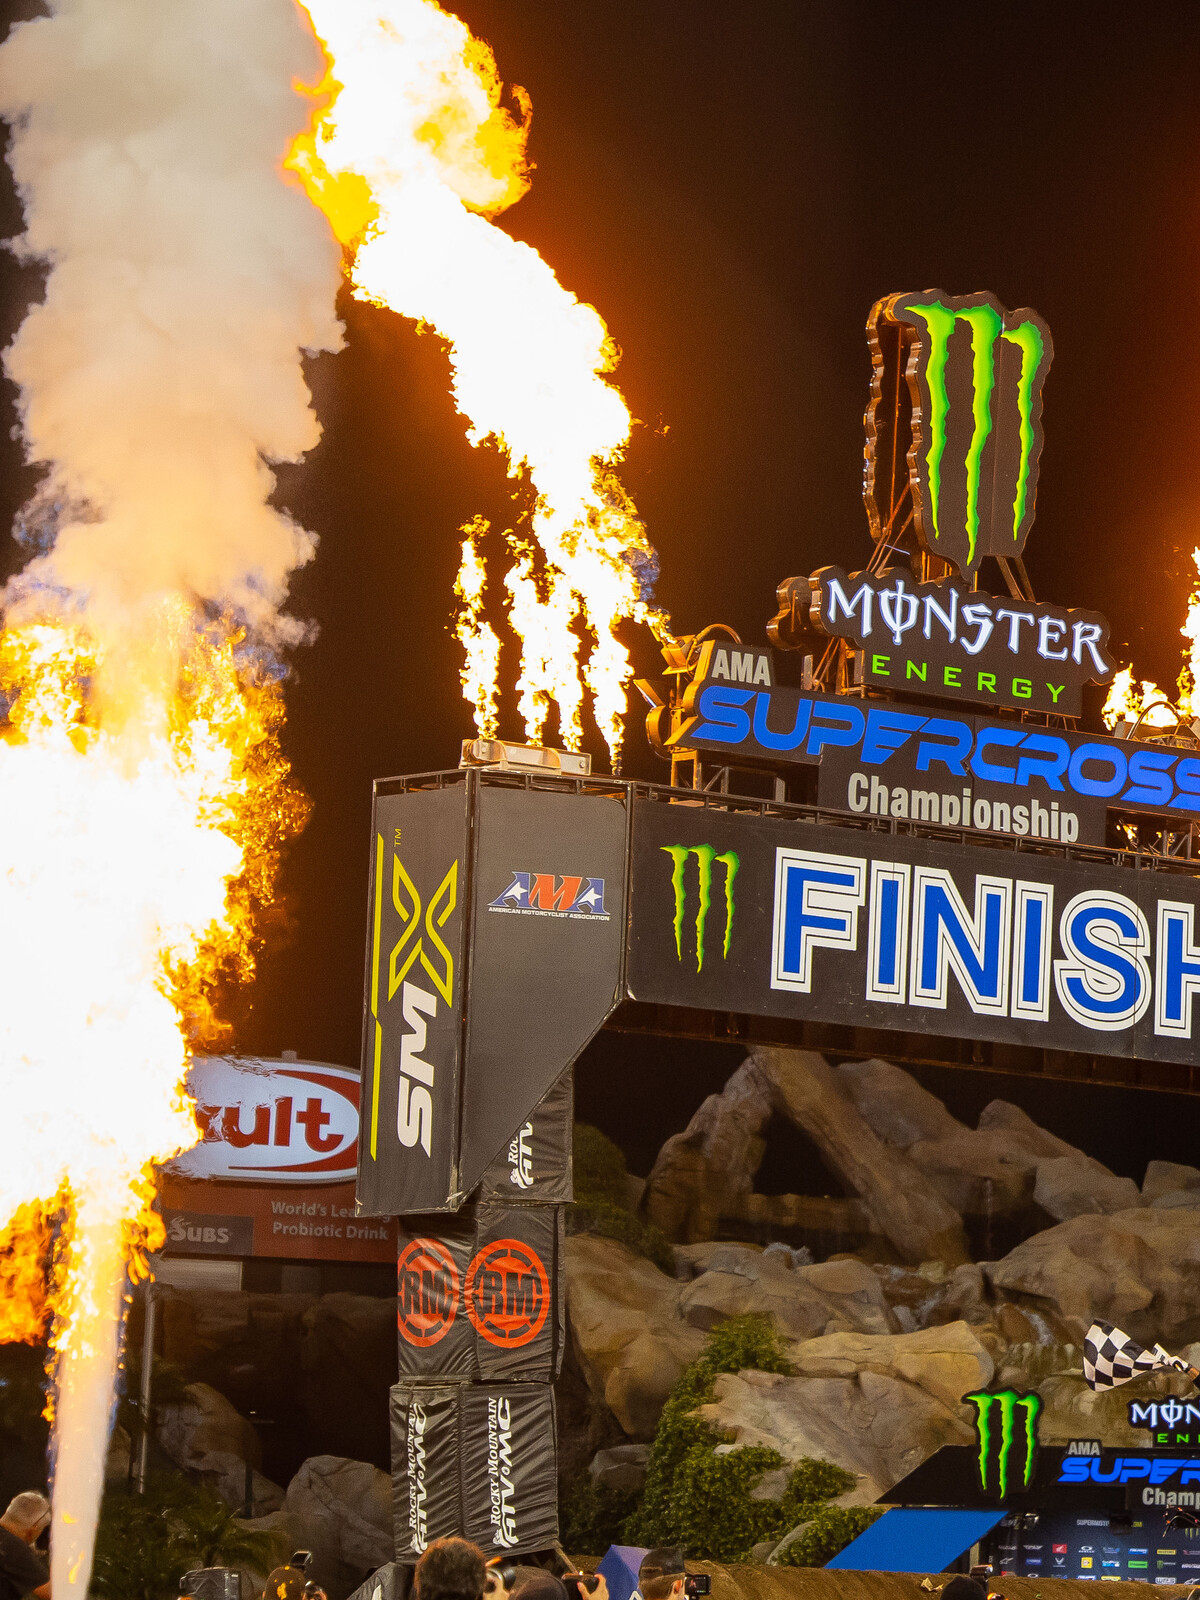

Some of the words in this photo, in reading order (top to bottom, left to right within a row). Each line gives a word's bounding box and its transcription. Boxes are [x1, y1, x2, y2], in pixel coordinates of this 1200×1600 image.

[711, 649, 772, 686] AMA
[872, 655, 1066, 702] ENERGY
[847, 773, 1080, 843] Championship
[487, 871, 611, 915] AMA
[488, 906, 521, 915] AMERICAN
[521, 909, 569, 918] MOTORCYCLIST
[569, 913, 610, 921] ASSOCIATION
[271, 1200, 328, 1216] World's
[273, 1221, 342, 1238] Probiotic
[346, 1225, 389, 1240] Drink
[488, 1397, 500, 1477] MOUNTAIN
[1068, 1442, 1100, 1455] AMA
[409, 1481, 417, 1529] ROCKY
[490, 1479, 500, 1525] ROCKY
